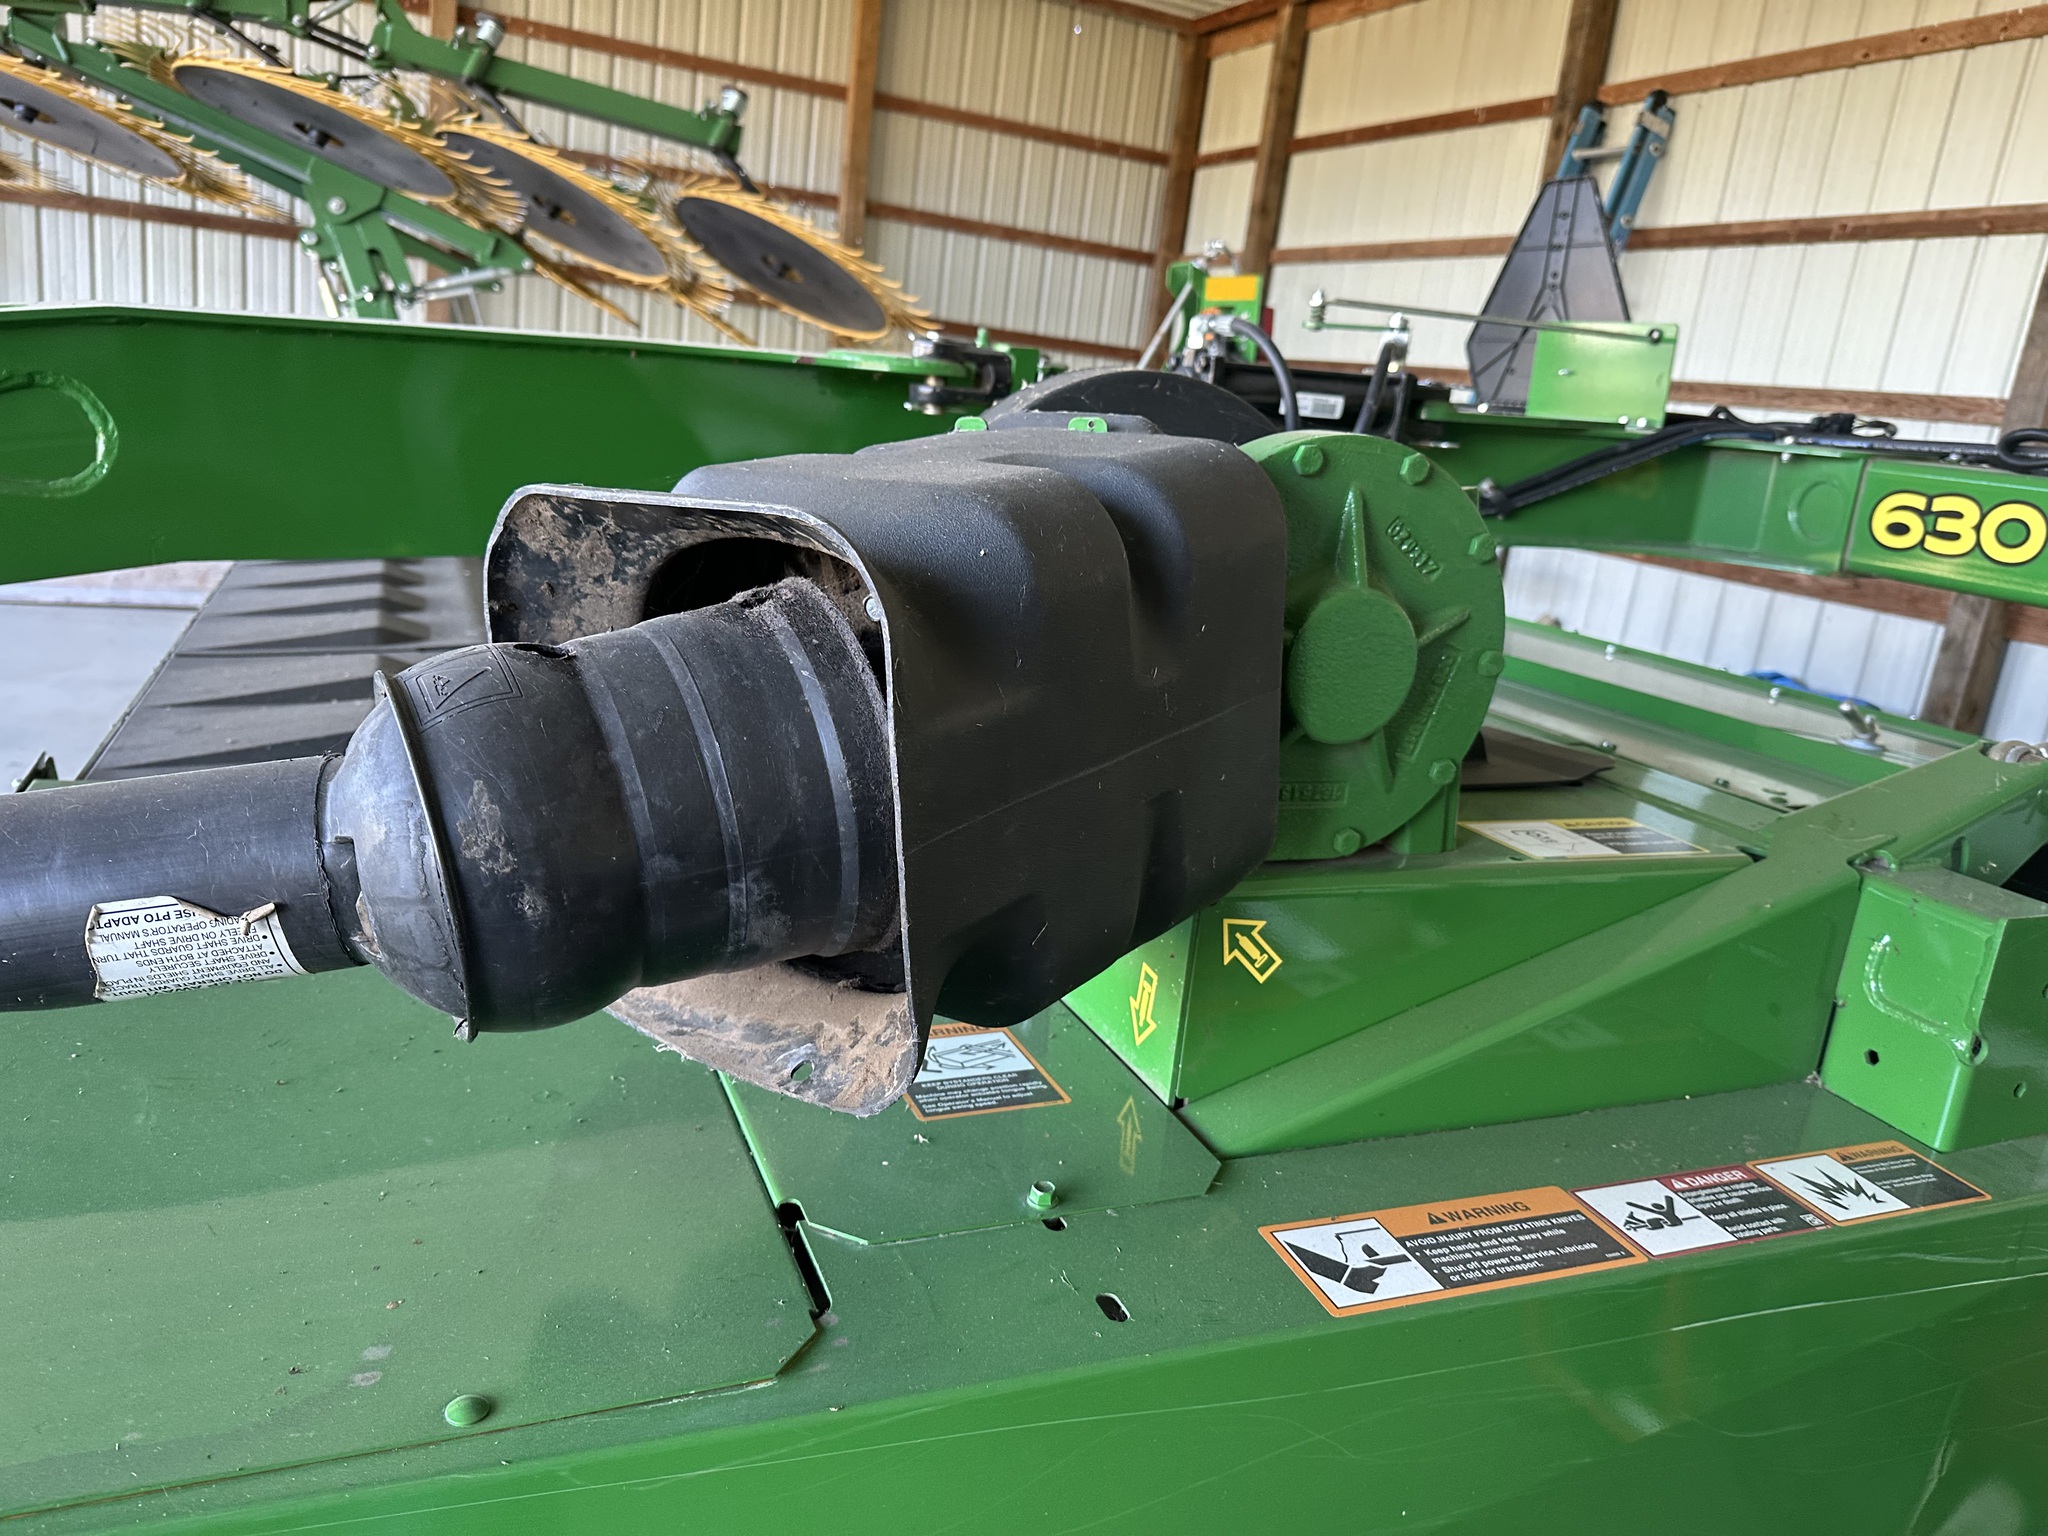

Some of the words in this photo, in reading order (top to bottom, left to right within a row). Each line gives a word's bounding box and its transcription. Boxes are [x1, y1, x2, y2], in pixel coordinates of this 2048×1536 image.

[1870, 490, 2048, 566] 630
[92, 915, 139, 929] ADAPT
[144, 911, 171, 923] PTO
[98, 930, 140, 943] MANUAL
[197, 931, 216, 940] ON
[220, 926, 257, 937] FEELY
[134, 938, 166, 949] SHAFT
[168, 933, 196, 945] DRIVE
[196, 938, 228, 949] SHAFT
[230, 934, 260, 944] DRIVE
[123, 950, 149, 959] THAT
[151, 944, 193, 955] GUARDS
[211, 944, 263, 955] ATTACHED
[238, 951, 267, 959] DRIVE
[92, 954, 121, 963] TURN
[136, 957, 163, 967] ENDS
[166, 953, 194, 963] BOTH
[204, 955, 235, 964] SHAFT
[149, 961, 201, 973] SECURELY
[191, 961, 247, 973] EQUIPMENT
[226, 967, 256, 976] DRIVE
[147, 970, 189, 980] SHIELDS
[194, 970, 224, 980] SHAFT
[172, 976, 232, 988] OPERATE
[942, 1076, 992, 1085] BYSTANDERS
[966, 1077, 1010, 1086] OPERATION
[915, 1092, 946, 1100] Machine
[989, 1083, 1018, 1091] position
[939, 1093, 969, 1101] operator
[970, 1089, 1000, 1097] actuates
[924, 1105, 951, 1113] tongue
[1684, 1170, 1748, 1187] DANGER
[1442, 1201, 1531, 1222] WARNING
[1405, 1237, 1440, 1248] AVOID
[1435, 1231, 1473, 1243] INJURY
[1472, 1226, 1503, 1237] FROM
[1501, 1219, 1552, 1232] ROTATING
[1549, 1214, 1586, 1225] KNIVES
[1423, 1247, 1450, 1256] Keep
[1448, 1242, 1480, 1252] hands
[1480, 1238, 1500, 1247] and
[1497, 1235, 1518, 1244] feet
[1517, 1232, 1542, 1241] away
[1541, 1228, 1567, 1237] while
[1431, 1252, 1473, 1264] machine
[1483, 1244, 1523, 1256] running.
[1441, 1264, 1467, 1274] Shut
[1466, 1260, 1481, 1270] off
[1480, 1257, 1510, 1268] power
[1522, 1249, 1560, 1260] service,
[1556, 1242, 1598, 1254] lubricate
[1449, 1274, 1462, 1282] or
[1460, 1269, 1483, 1280] fold
[1480, 1268, 1497, 1276] for
[1496, 1260, 1544, 1274] transport.
